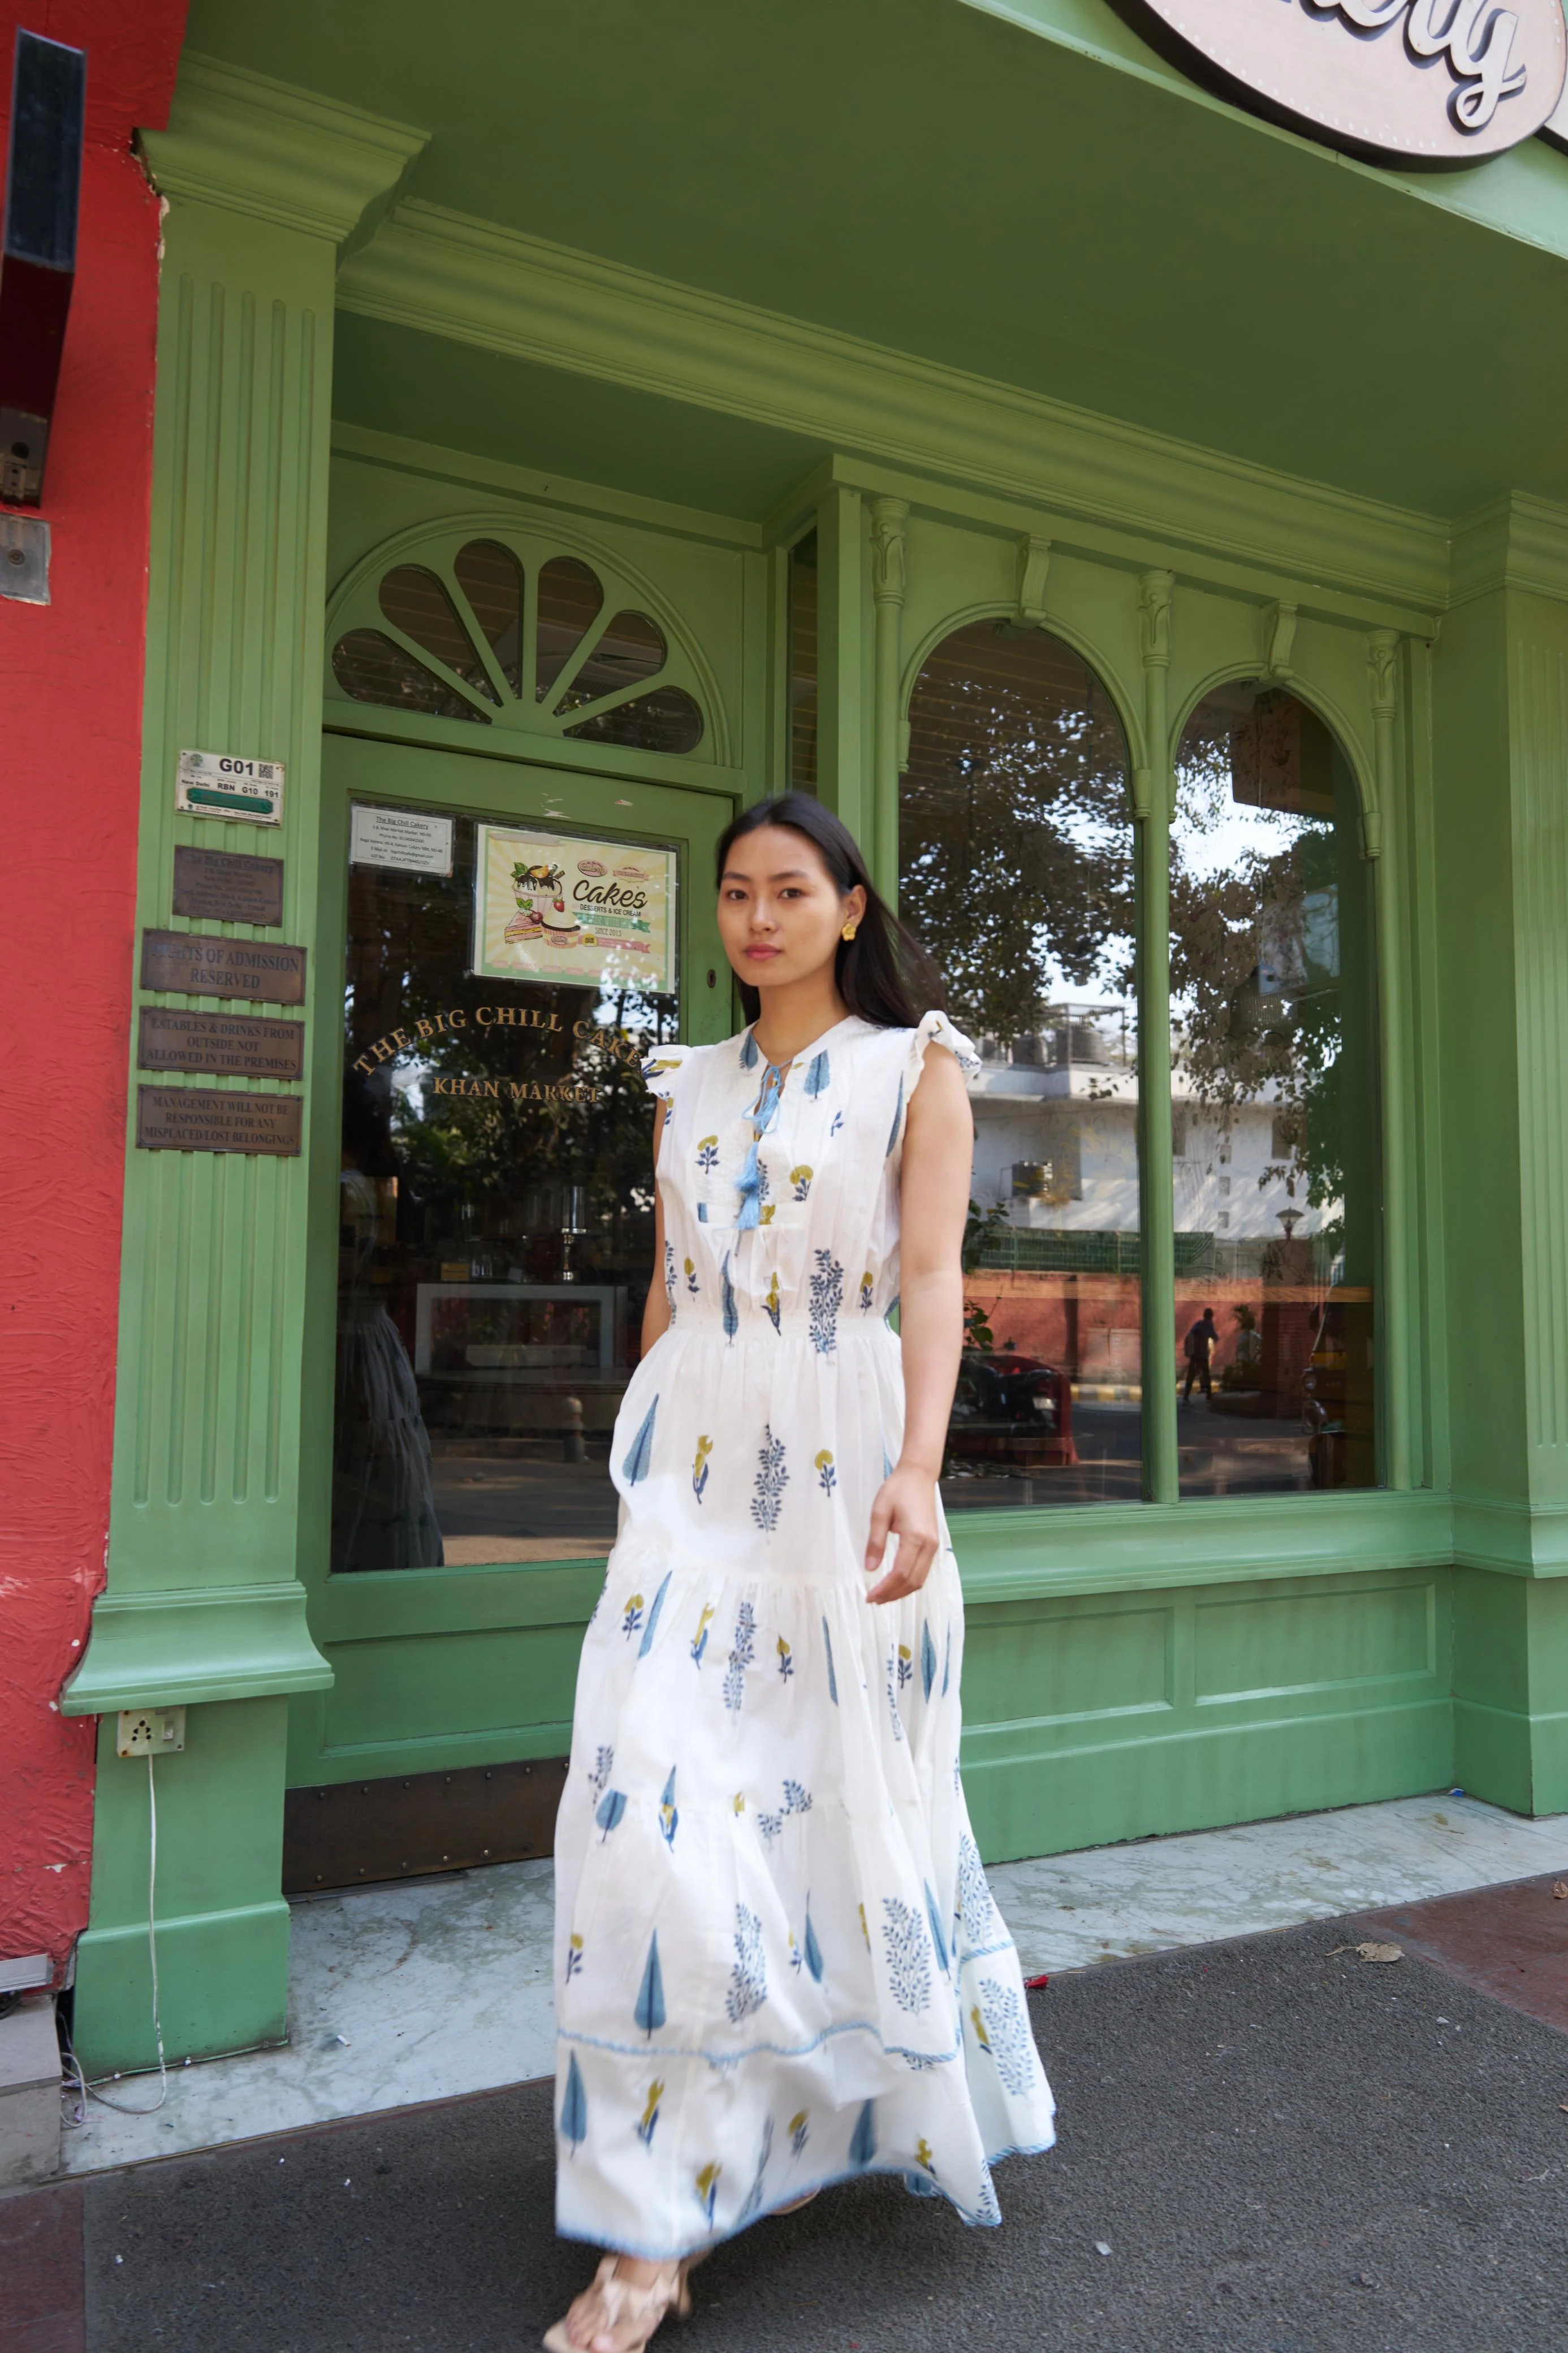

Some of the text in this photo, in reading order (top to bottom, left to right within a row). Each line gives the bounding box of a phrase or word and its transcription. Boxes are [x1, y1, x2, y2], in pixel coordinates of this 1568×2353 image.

[219, 758, 254, 776] G01
[217, 782, 236, 791] RBN
[241, 786, 258, 795] G10
[264, 790, 279, 799] 191
[573, 880, 648, 909] Cakes
[580, 904, 607, 913] DESSERTS
[595, 927, 609, 936] SINCE
[150, 942, 299, 972] RIGHTS OF ADMISSION
[190, 968, 260, 989] RESERVED
[150, 1018, 295, 1040] EATABLES & DRINKS FROM
[187, 1036, 260, 1052] OUTSIDE NOT
[353, 1007, 643, 1076] THE BIG CHILL CAKE
[146, 1049, 297, 1070] ALLOWED IN THE PREMISES
[433, 1076, 601, 1104] KHAN MARKET
[152, 1096, 290, 1115] MANAGEMENT WILL NOT BE
[165, 1112, 277, 1130] RESPONSIBLE FOR ANY
[232, 1132, 296, 1145] BELONGINGS
